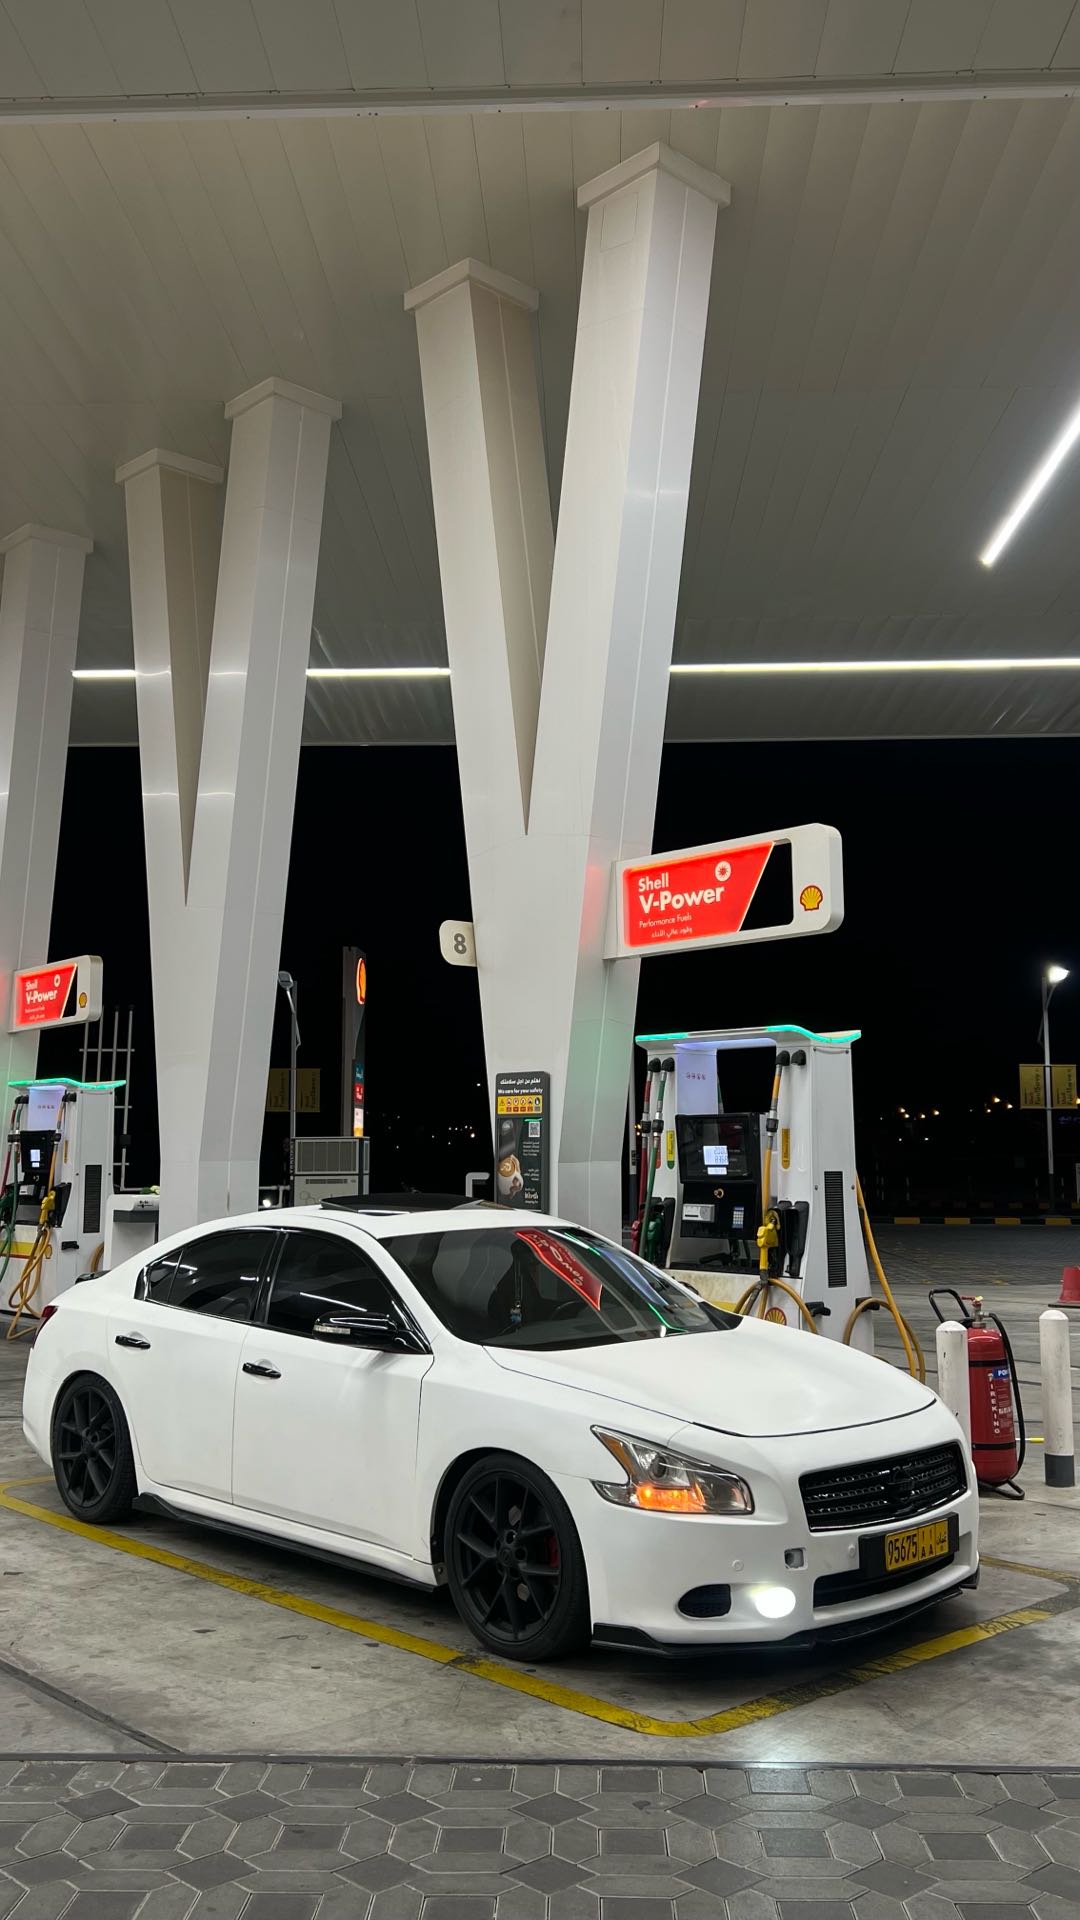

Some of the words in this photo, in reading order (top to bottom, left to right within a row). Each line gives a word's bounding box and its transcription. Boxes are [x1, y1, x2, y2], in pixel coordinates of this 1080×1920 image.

[638, 872, 669, 892] Shell
[638, 886, 725, 914] V-Power
[639, 917, 676, 929] Performance
[676, 912, 692, 922] Fuels
[454, 933, 466, 954] 8
[26, 979, 38, 990] Shell
[26, 990, 58, 1004] V-Power
[888, 1534, 918, 1566] 95675
